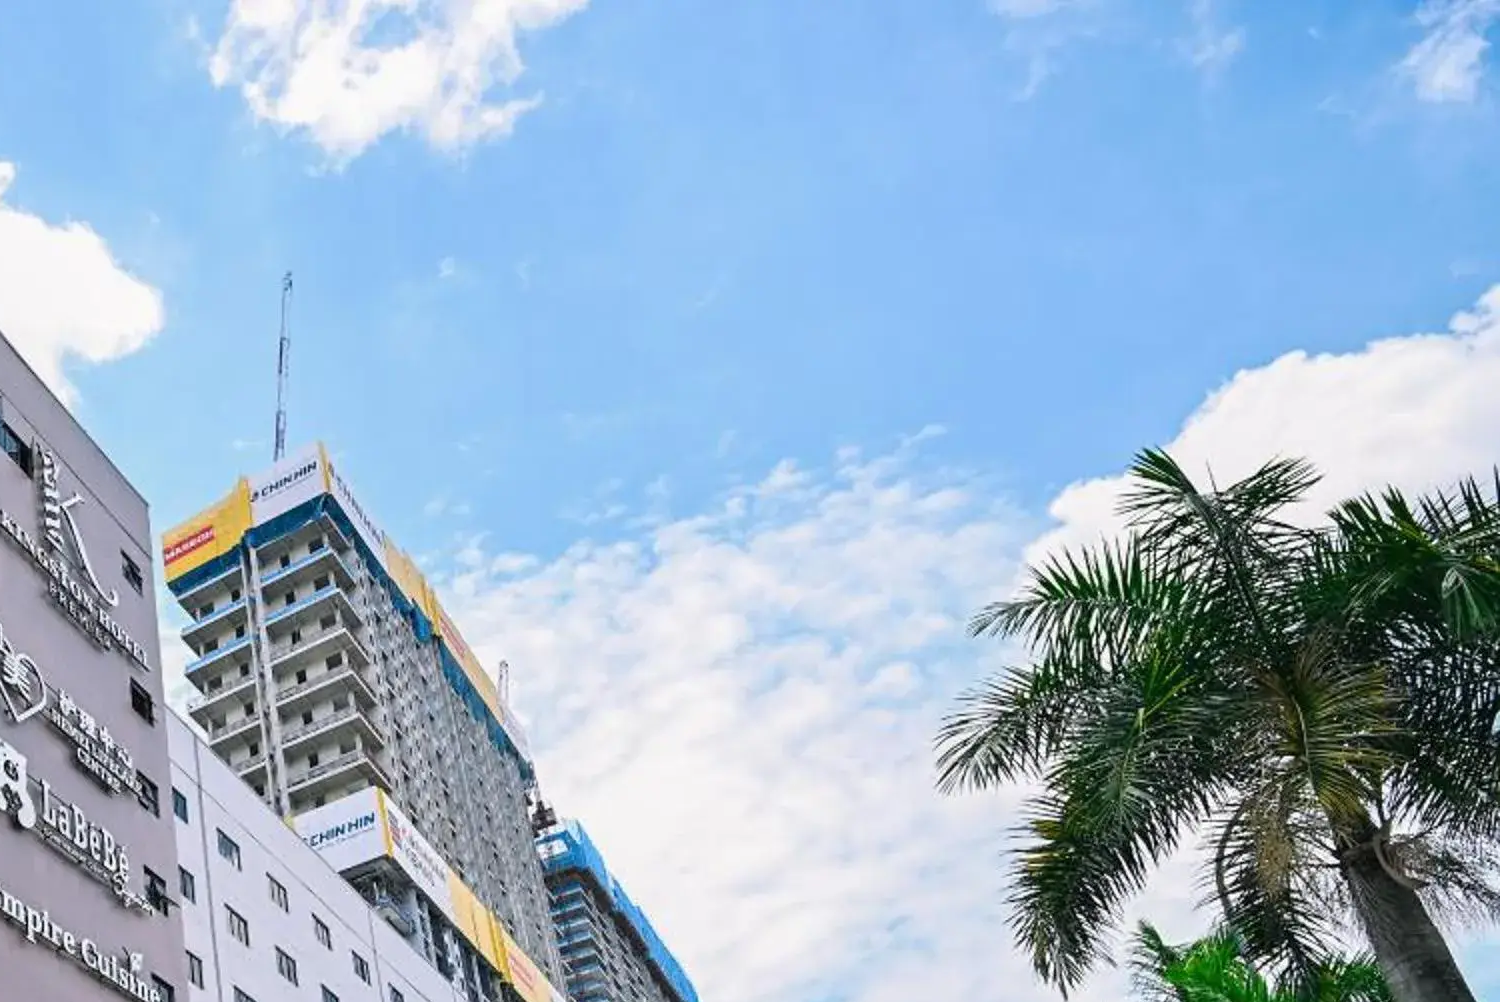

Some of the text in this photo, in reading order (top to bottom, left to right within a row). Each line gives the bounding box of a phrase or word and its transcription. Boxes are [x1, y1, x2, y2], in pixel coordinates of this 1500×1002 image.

[0, 508, 151, 670] KINGSTON HOTEL
[48, 578, 113, 651] PREMIER
[310, 812, 375, 847] CHIN HIN
